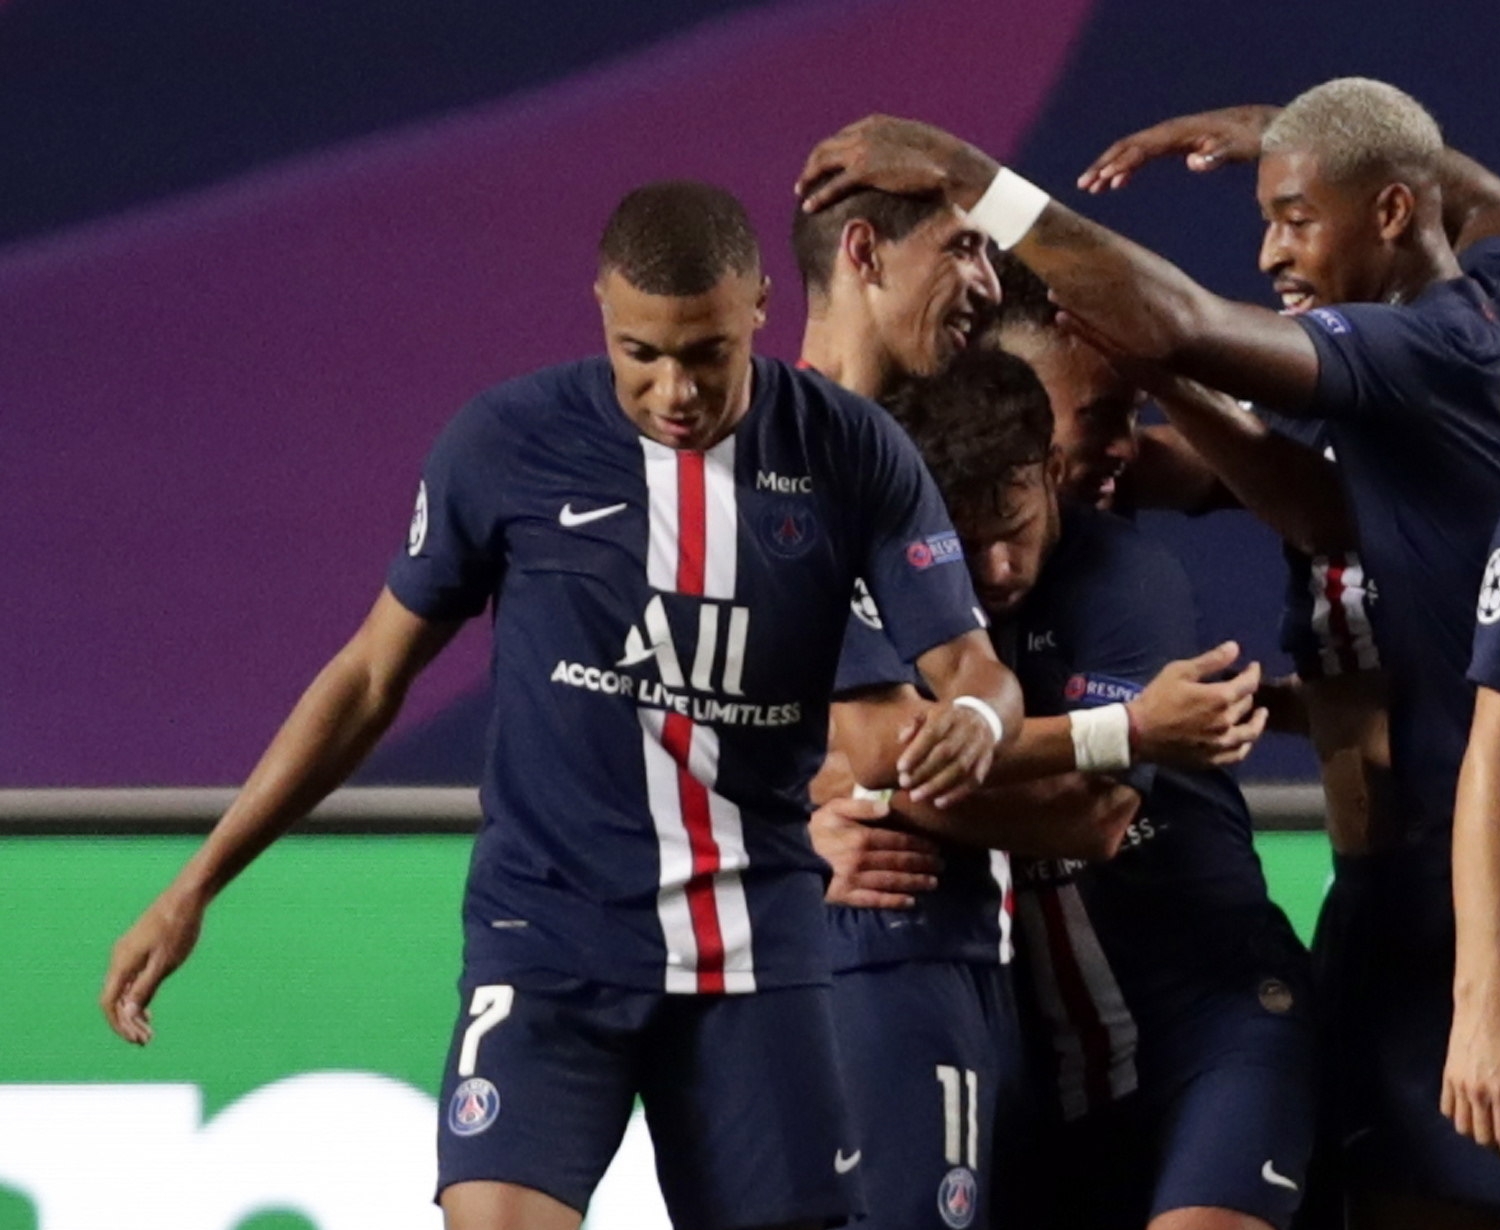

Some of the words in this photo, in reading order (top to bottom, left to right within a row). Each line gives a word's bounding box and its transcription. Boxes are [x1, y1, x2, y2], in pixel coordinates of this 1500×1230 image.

[551, 660, 634, 697] ACCOR
[639, 679, 690, 714] LIVE
[693, 700, 802, 727] LIMITLESS
[459, 984, 514, 1077] 7
[936, 1065, 978, 1171] 11
